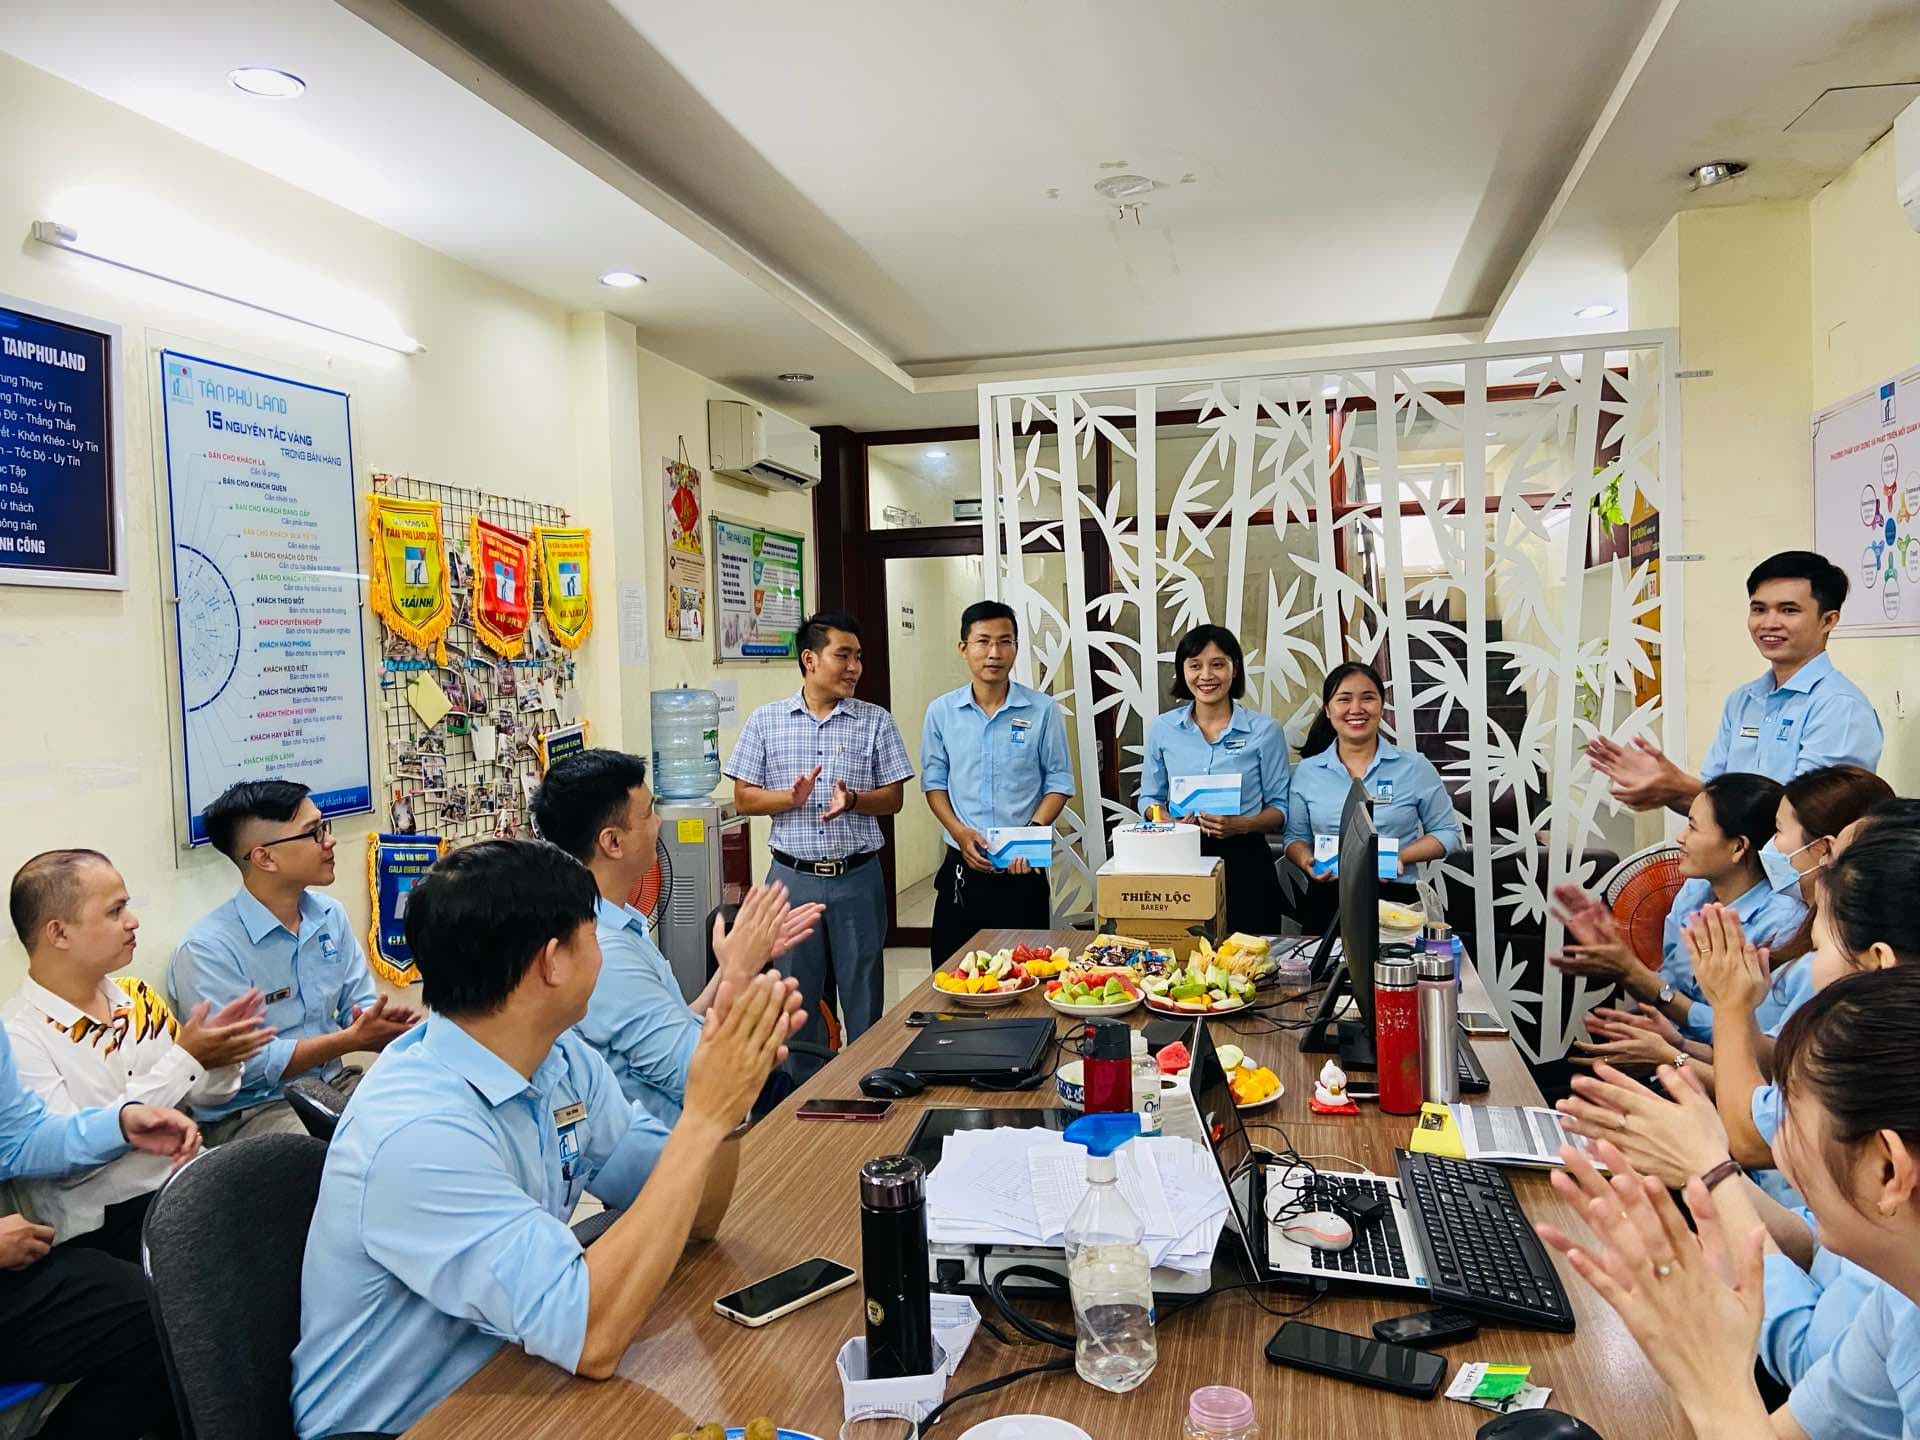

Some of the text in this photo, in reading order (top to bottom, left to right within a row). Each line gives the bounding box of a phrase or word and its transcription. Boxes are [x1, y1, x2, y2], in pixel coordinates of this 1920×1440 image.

[2, 336, 86, 372] TANPHULAND
[20, 376, 43, 390] Thực
[197, 378, 287, 415] TÂN PHÚ LAND
[44, 400, 56, 412] Uy
[206, 409, 223, 430] 15
[225, 420, 266, 439] NGUYÊN
[72, 439, 84, 452] Uy
[54, 453, 65, 466] Uy
[236, 479, 249, 488] CHO
[10, 500, 34, 513] thách
[0, 518, 18, 531] ông
[17, 536, 46, 554] CÔNG
[1120, 890, 1191, 904] THIÊN LỘC
